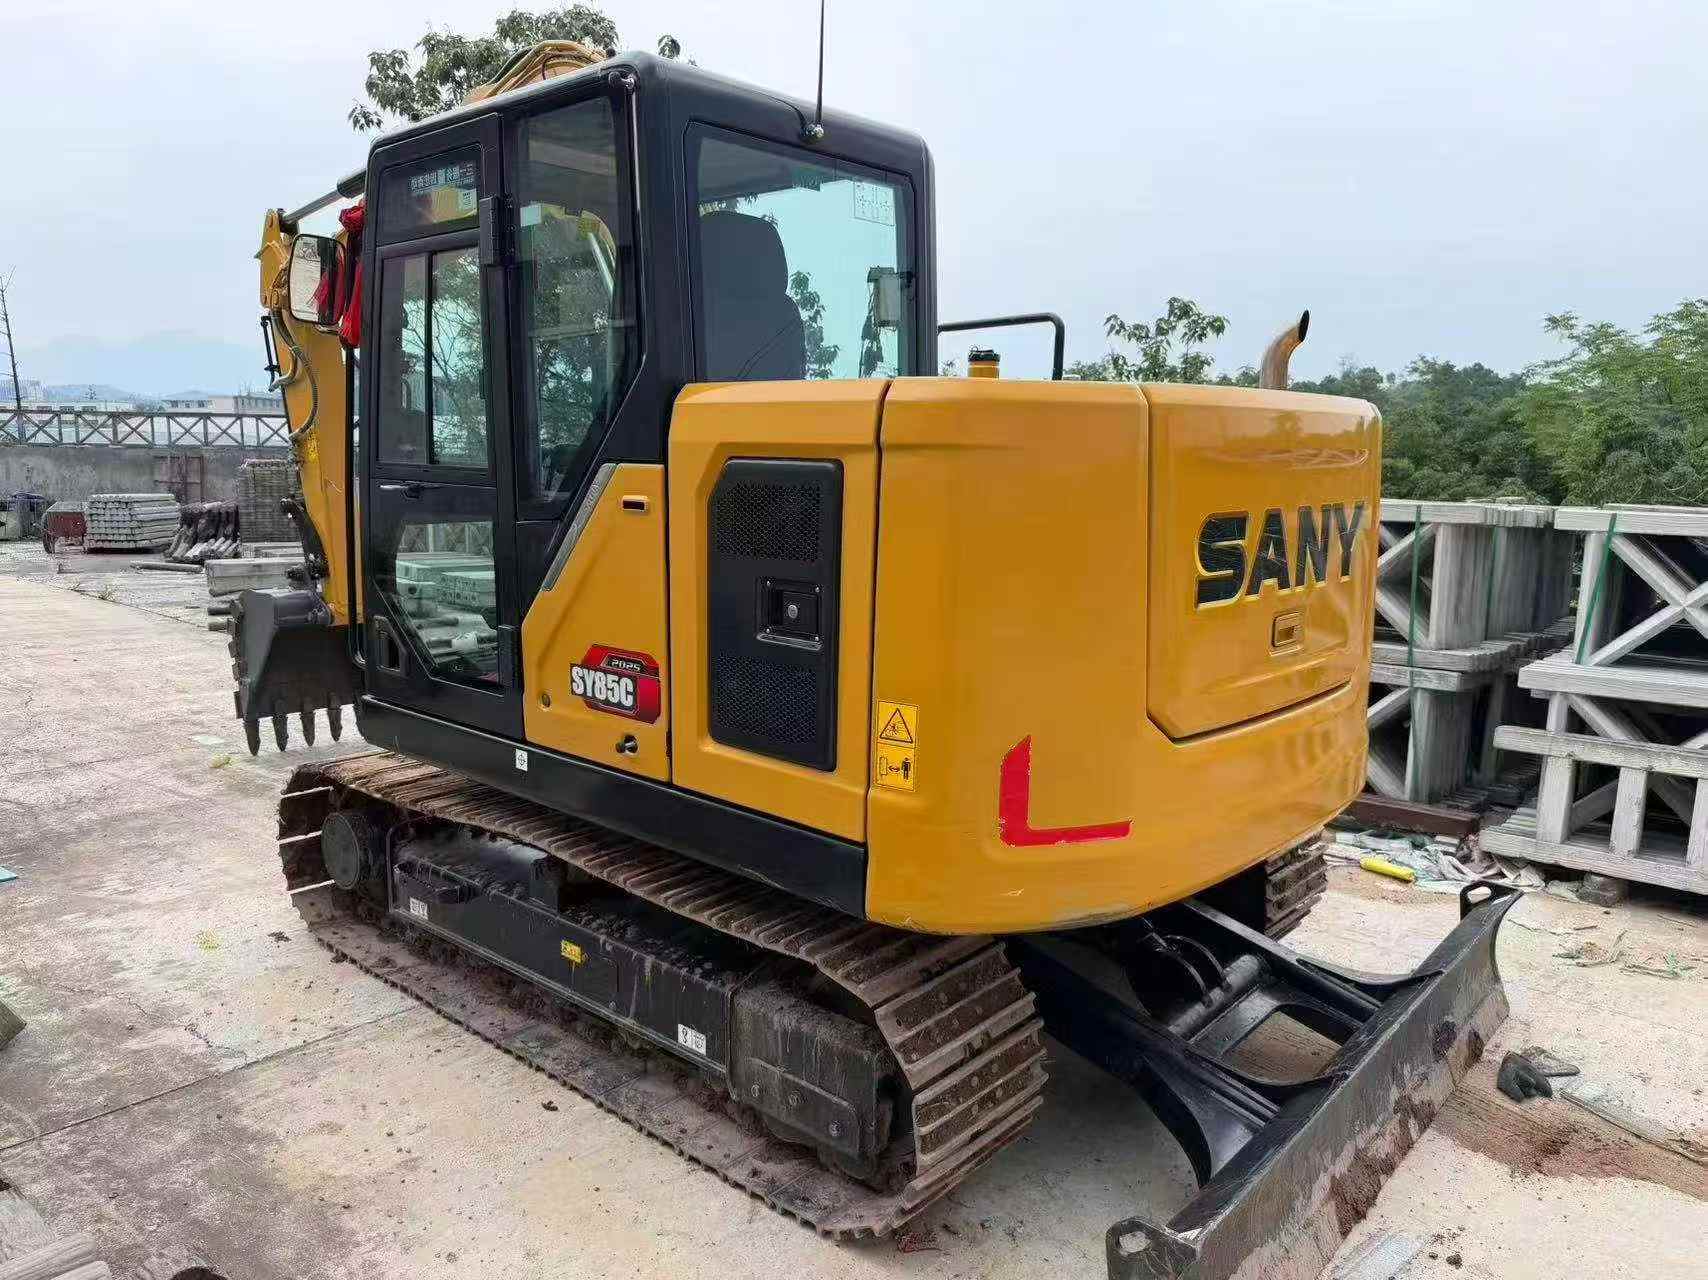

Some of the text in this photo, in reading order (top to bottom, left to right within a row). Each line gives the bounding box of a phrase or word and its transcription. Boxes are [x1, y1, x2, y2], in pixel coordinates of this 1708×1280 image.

[1195, 502, 1365, 609] SANY
[611, 659, 641, 671] 2025
[571, 666, 634, 706] SY85C
